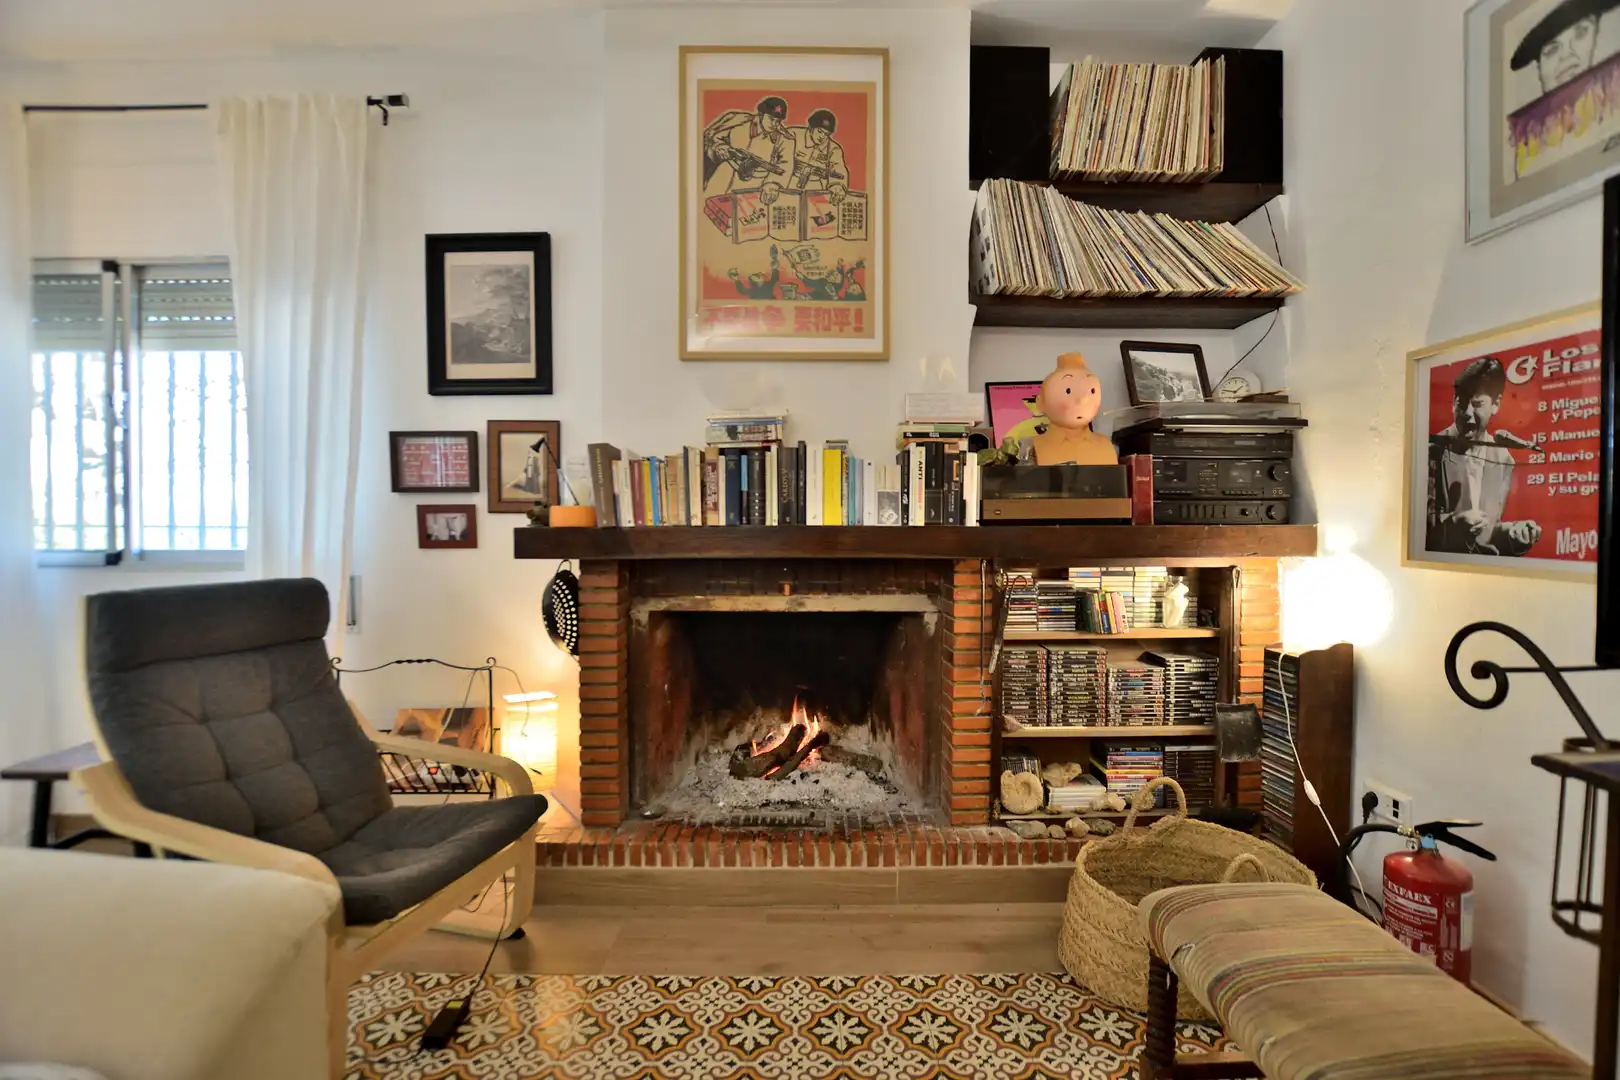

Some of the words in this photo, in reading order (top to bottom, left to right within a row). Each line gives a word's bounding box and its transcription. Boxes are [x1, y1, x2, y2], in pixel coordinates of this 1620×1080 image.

[1542, 344, 1599, 362] Los
[1537, 401, 1547, 411] 8
[1551, 413, 1559, 423] y
[1532, 432, 1546, 443] 15
[1528, 453, 1545, 464] 22
[1549, 450, 1594, 463] Mario
[1527, 473, 1544, 485] 29
[1548, 472, 1563, 484] El
[1548, 486, 1556, 496] y
[1559, 485, 1577, 493] su
[1556, 528, 1598, 559] Mayo
